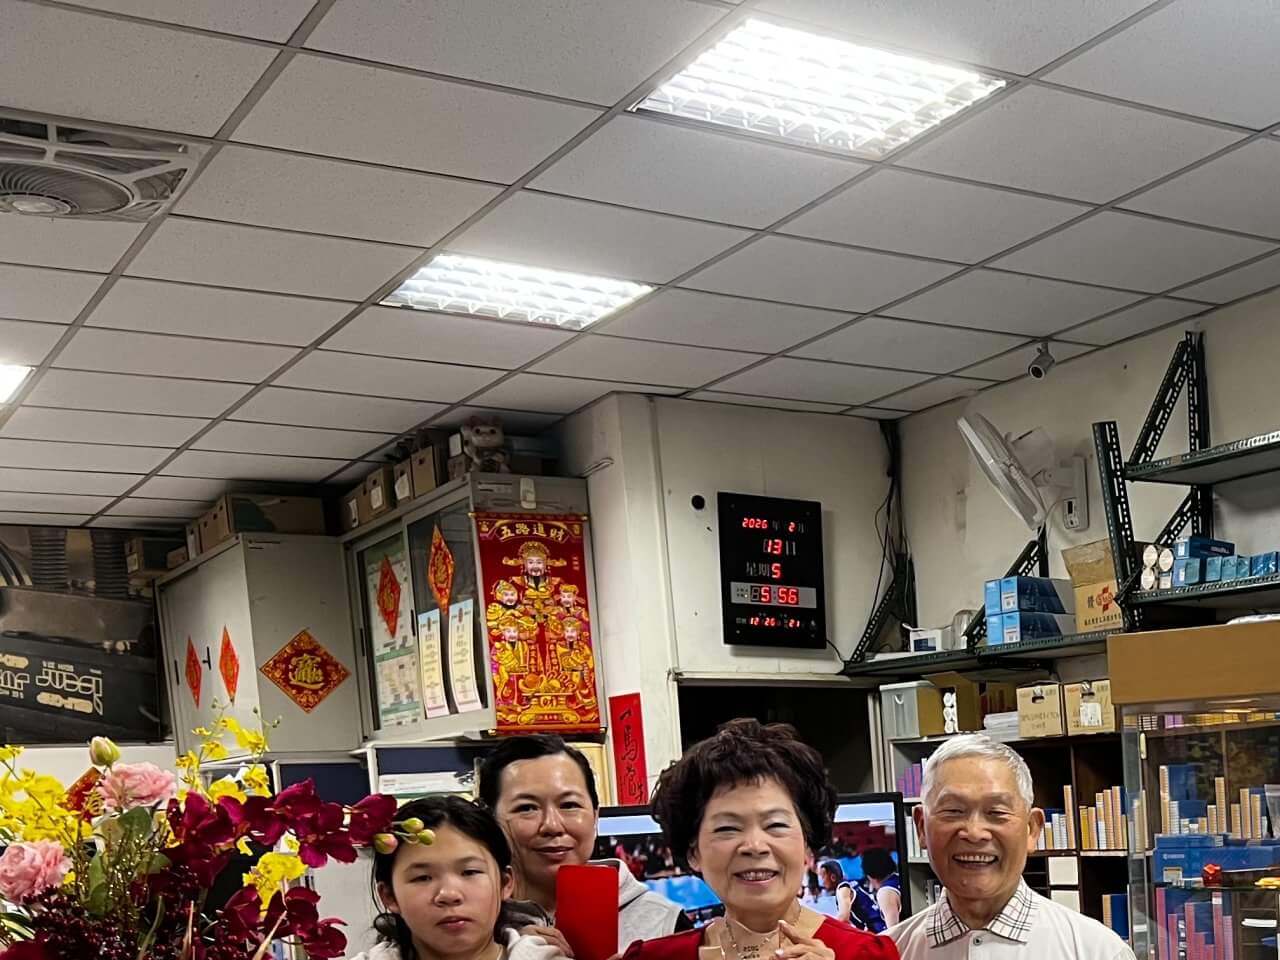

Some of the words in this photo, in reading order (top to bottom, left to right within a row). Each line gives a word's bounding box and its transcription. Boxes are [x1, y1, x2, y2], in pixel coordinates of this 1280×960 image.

[500, 522, 565, 543] 五路進財
[742, 517, 768, 529] 2026
[788, 522, 796, 533] 2
[767, 539, 783, 555] 13
